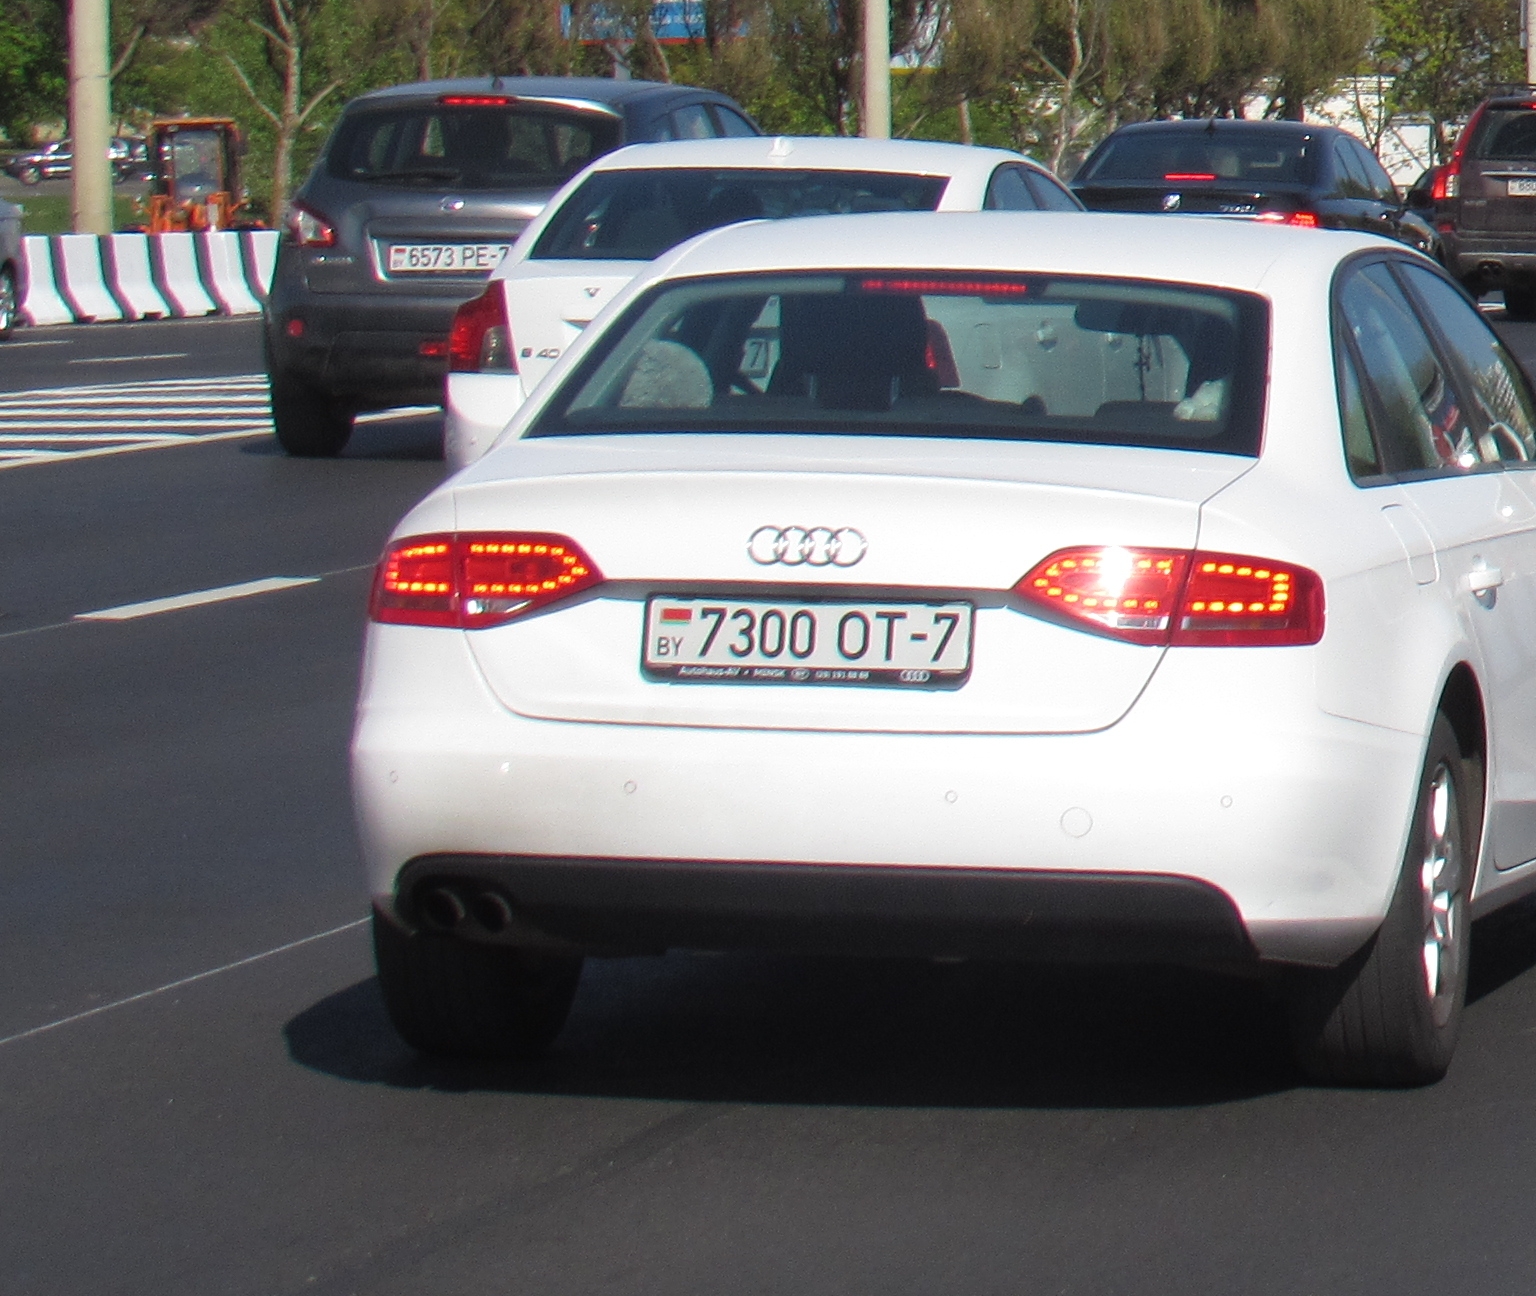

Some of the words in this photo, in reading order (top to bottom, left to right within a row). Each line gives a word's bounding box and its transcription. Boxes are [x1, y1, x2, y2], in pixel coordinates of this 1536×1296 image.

[409, 247, 455, 267] 6573
[537, 348, 561, 359] 40
[699, 607, 817, 659] 7300
[837, 609, 960, 663] OT-7
[656, 636, 684, 656] BY
